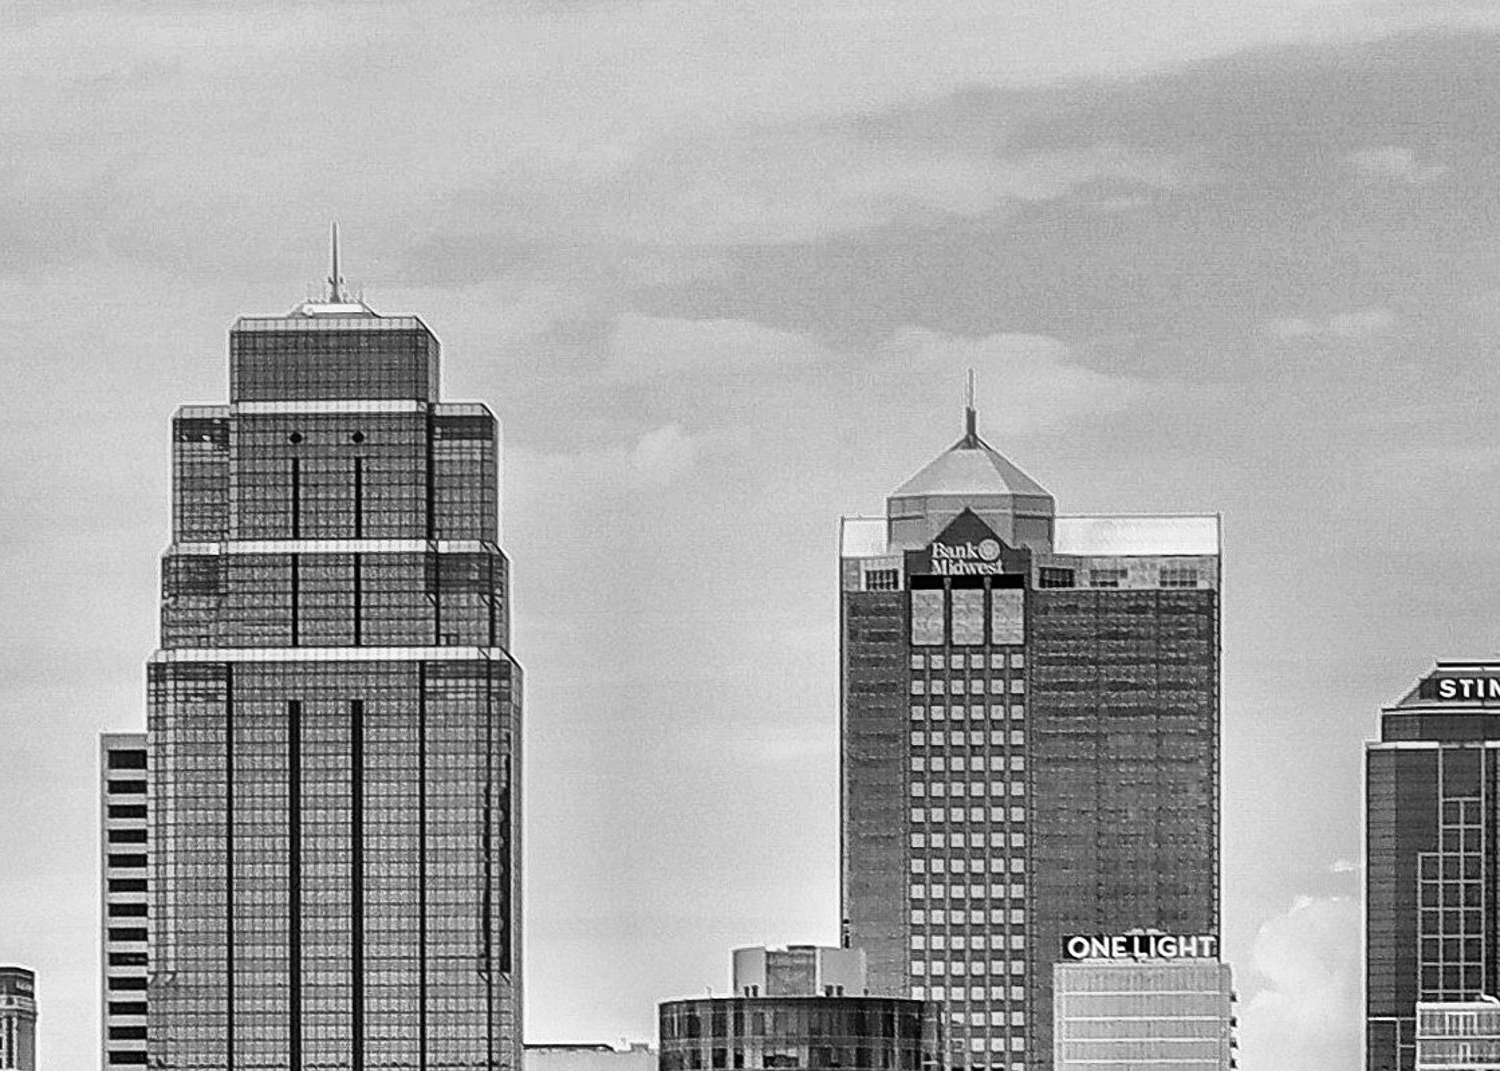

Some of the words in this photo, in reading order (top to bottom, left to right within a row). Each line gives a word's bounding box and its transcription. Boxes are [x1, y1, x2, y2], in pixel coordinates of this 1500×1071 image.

[932, 541, 979, 559] Bank
[931, 559, 1004, 575] Midwest
[1067, 936, 1127, 958] ONE
[1133, 936, 1216, 958] LIGHT
